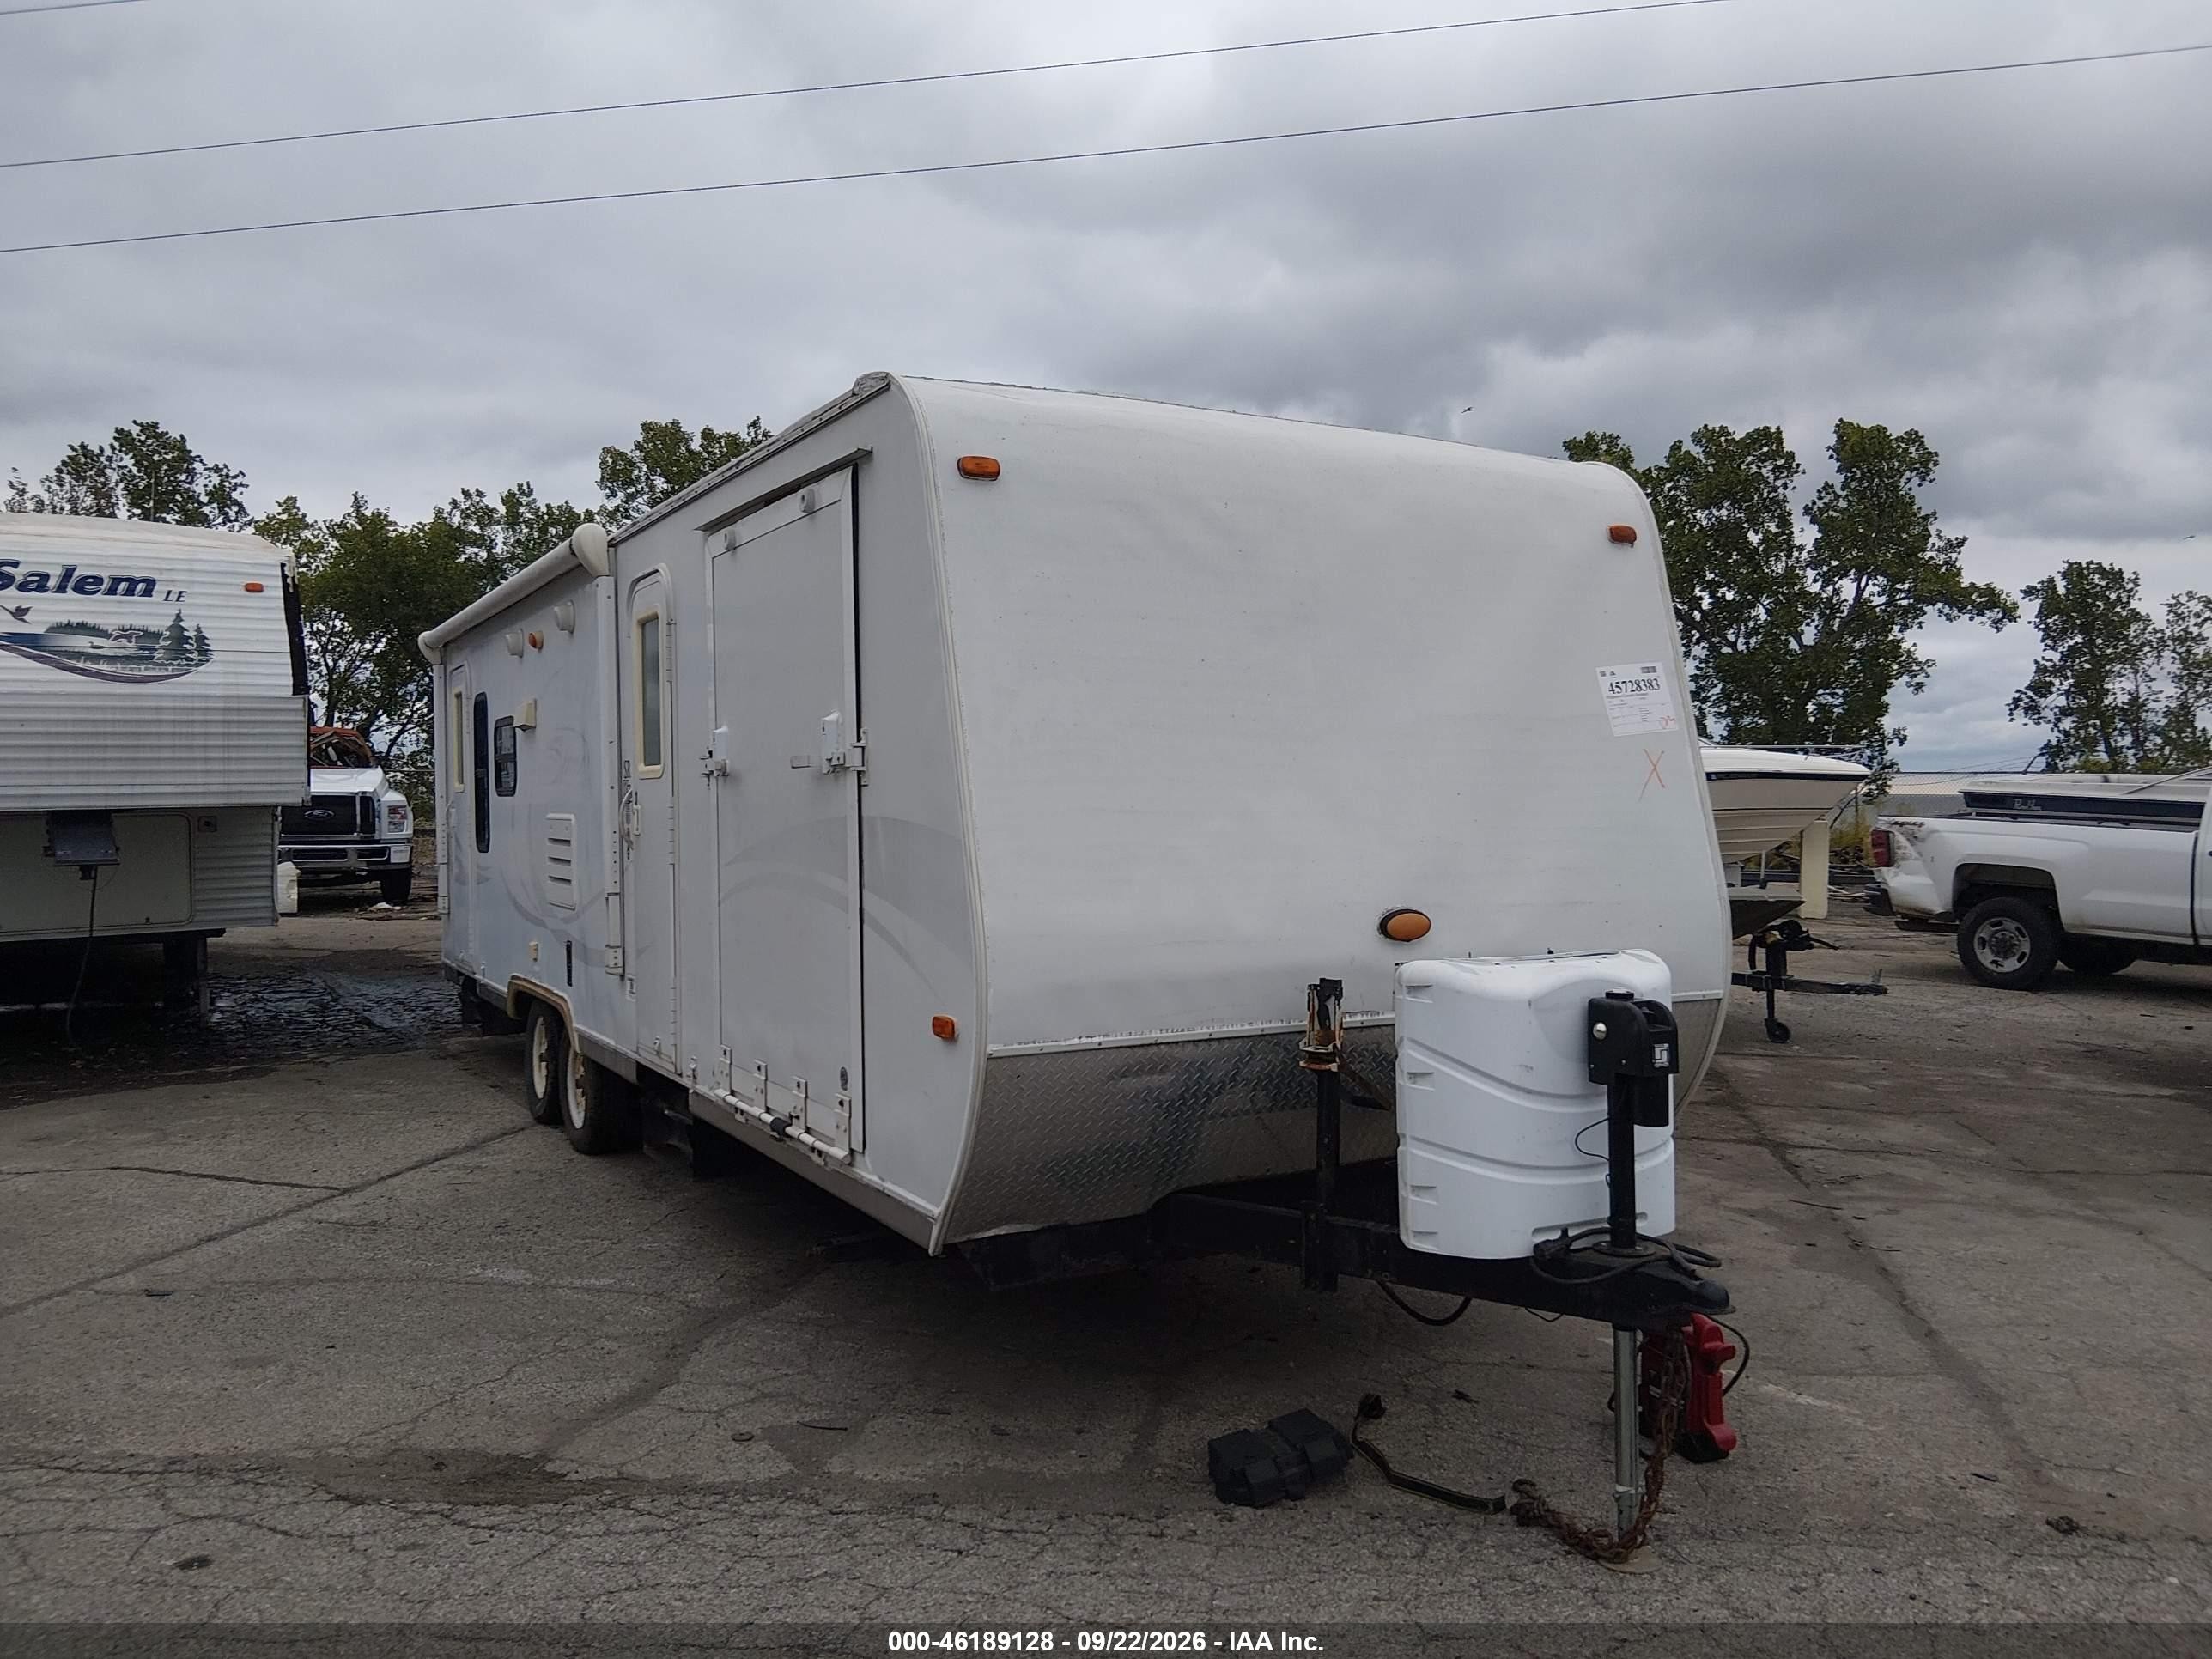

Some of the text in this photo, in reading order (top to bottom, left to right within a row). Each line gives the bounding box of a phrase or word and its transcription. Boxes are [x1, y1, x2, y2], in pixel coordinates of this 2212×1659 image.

[0, 558, 187, 602] Salem LE
[1608, 678, 1660, 694] 45728383
